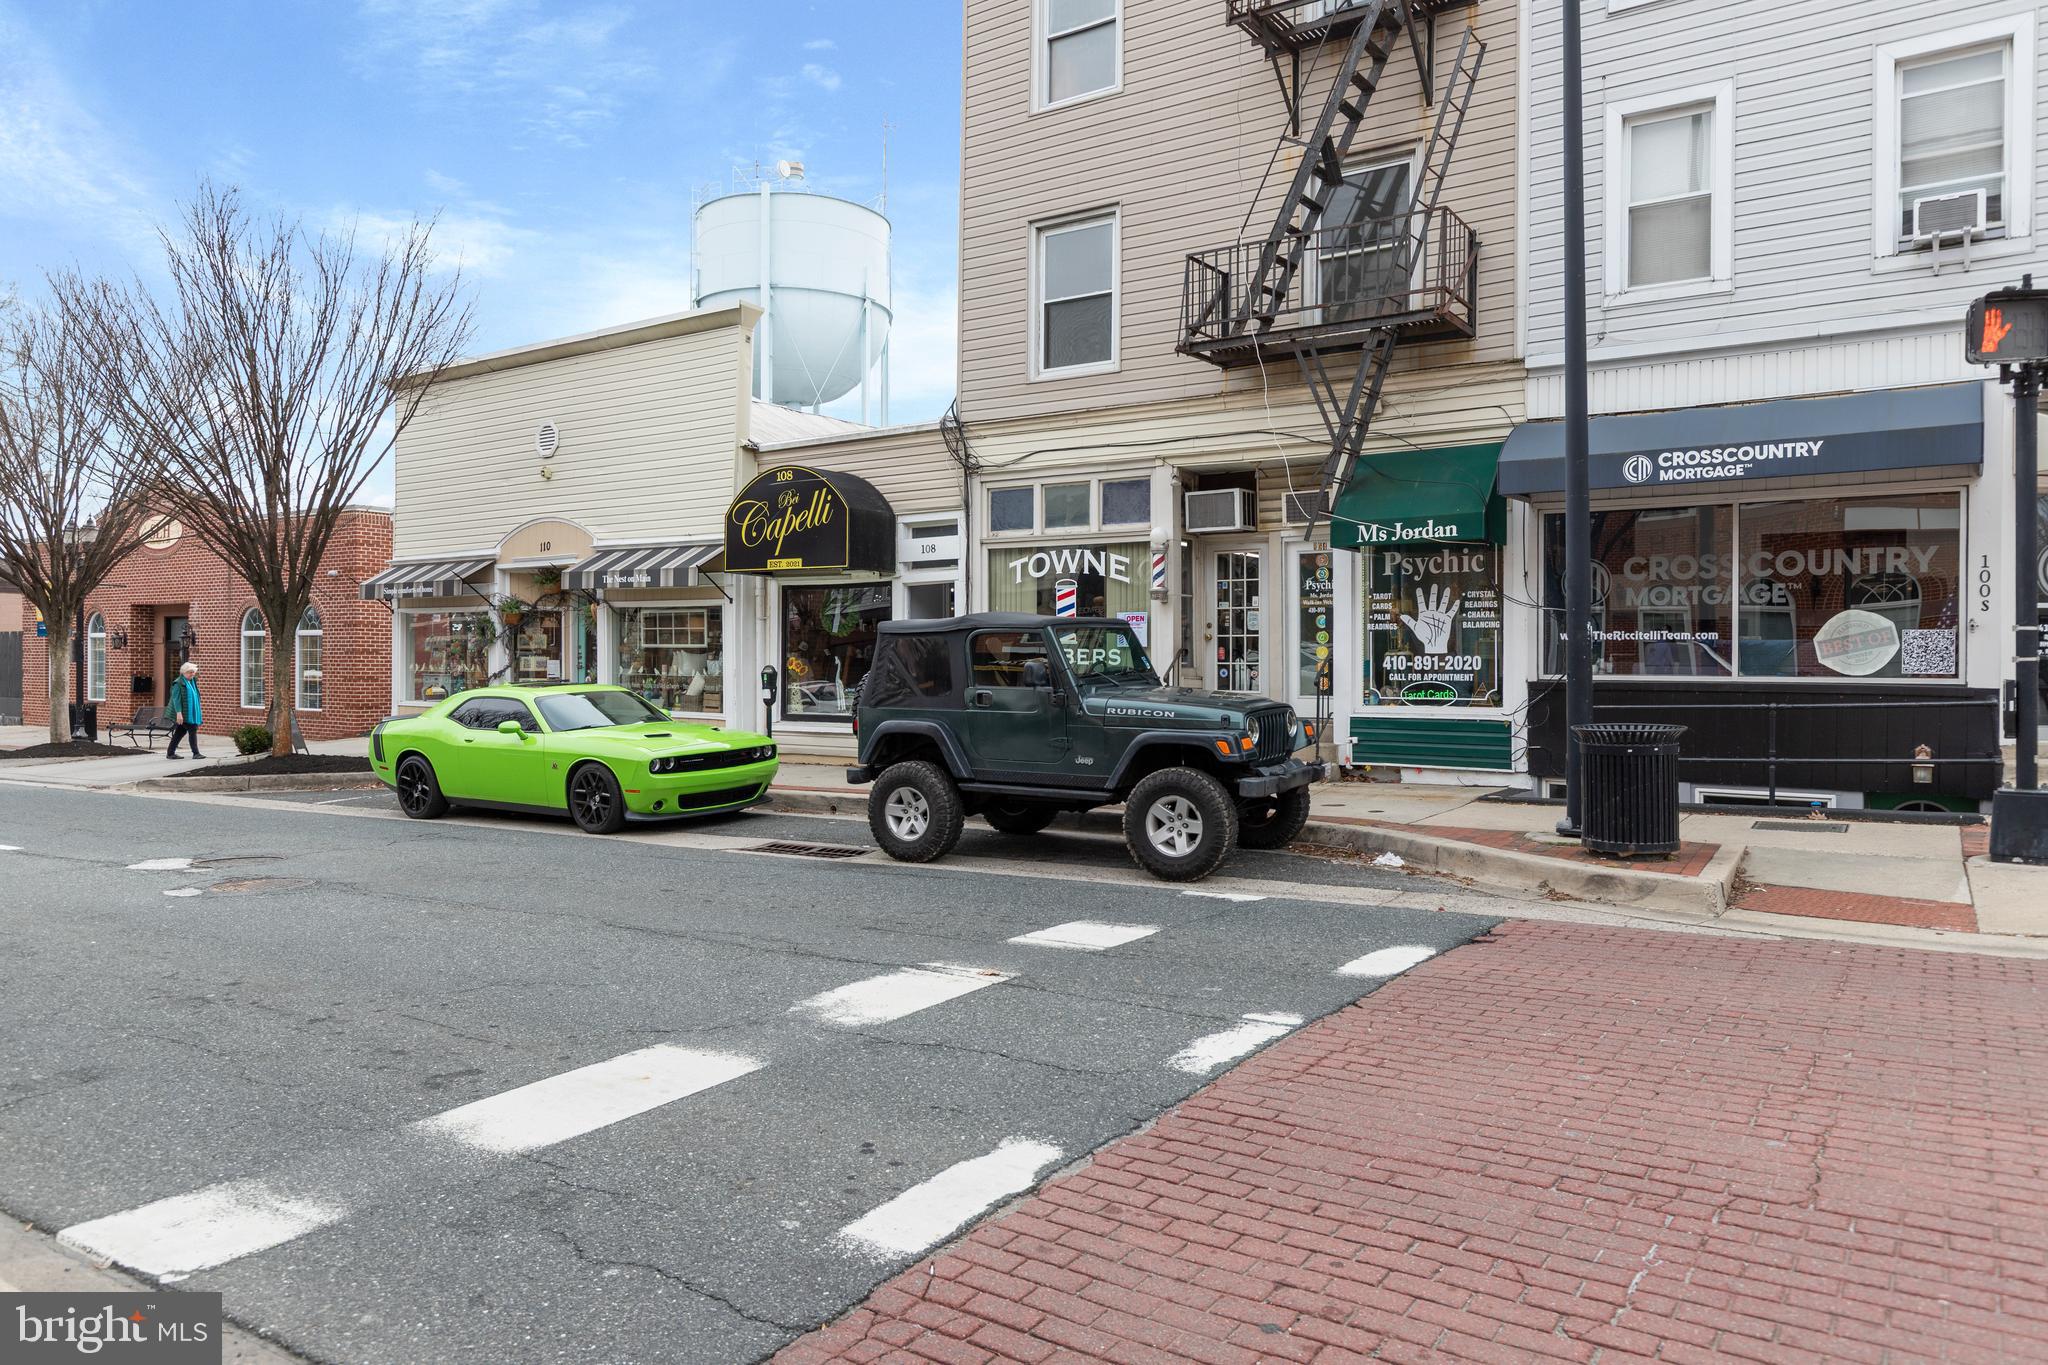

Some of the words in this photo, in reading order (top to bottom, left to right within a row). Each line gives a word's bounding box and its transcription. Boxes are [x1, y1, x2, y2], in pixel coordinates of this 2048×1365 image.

[1657, 440, 1825, 467] CROSSCOUNTRY
[776, 470, 794, 482] 108
[778, 488, 800, 508] Bei
[732, 487, 834, 556] Capelli
[1356, 524, 1388, 543] Ms
[1391, 520, 1458, 541] Jordan
[540, 541, 551, 552] 110
[921, 544, 936, 554] 108
[1009, 549, 1131, 584] TOWNE
[1382, 548, 1485, 581] Psychic
[1622, 545, 1940, 582] CROSSCOUNTRY
[602, 575, 613, 583] The
[614, 575, 627, 583] Nest
[1306, 579, 1333, 592] Psychi
[1373, 592, 1392, 600] TAROT
[1467, 590, 1495, 598] CRYSTAL
[1372, 602, 1392, 610] CARDS
[1374, 613, 1390, 621] PALM
[1467, 611, 1495, 619] CHAKRA
[1463, 621, 1500, 629] BALANCING
[1822, 635, 1861, 656] BEST
[1867, 630, 1890, 646] OF
[1382, 655, 1482, 671] 410-891-2020
[1423, 673, 1474, 681] APPOINTMENT
[1403, 690, 1425, 699] Tarot
[1427, 689, 1455, 699] Cards
[1106, 707, 1175, 718] RUBICON
[1075, 755, 1094, 766] Jeep
